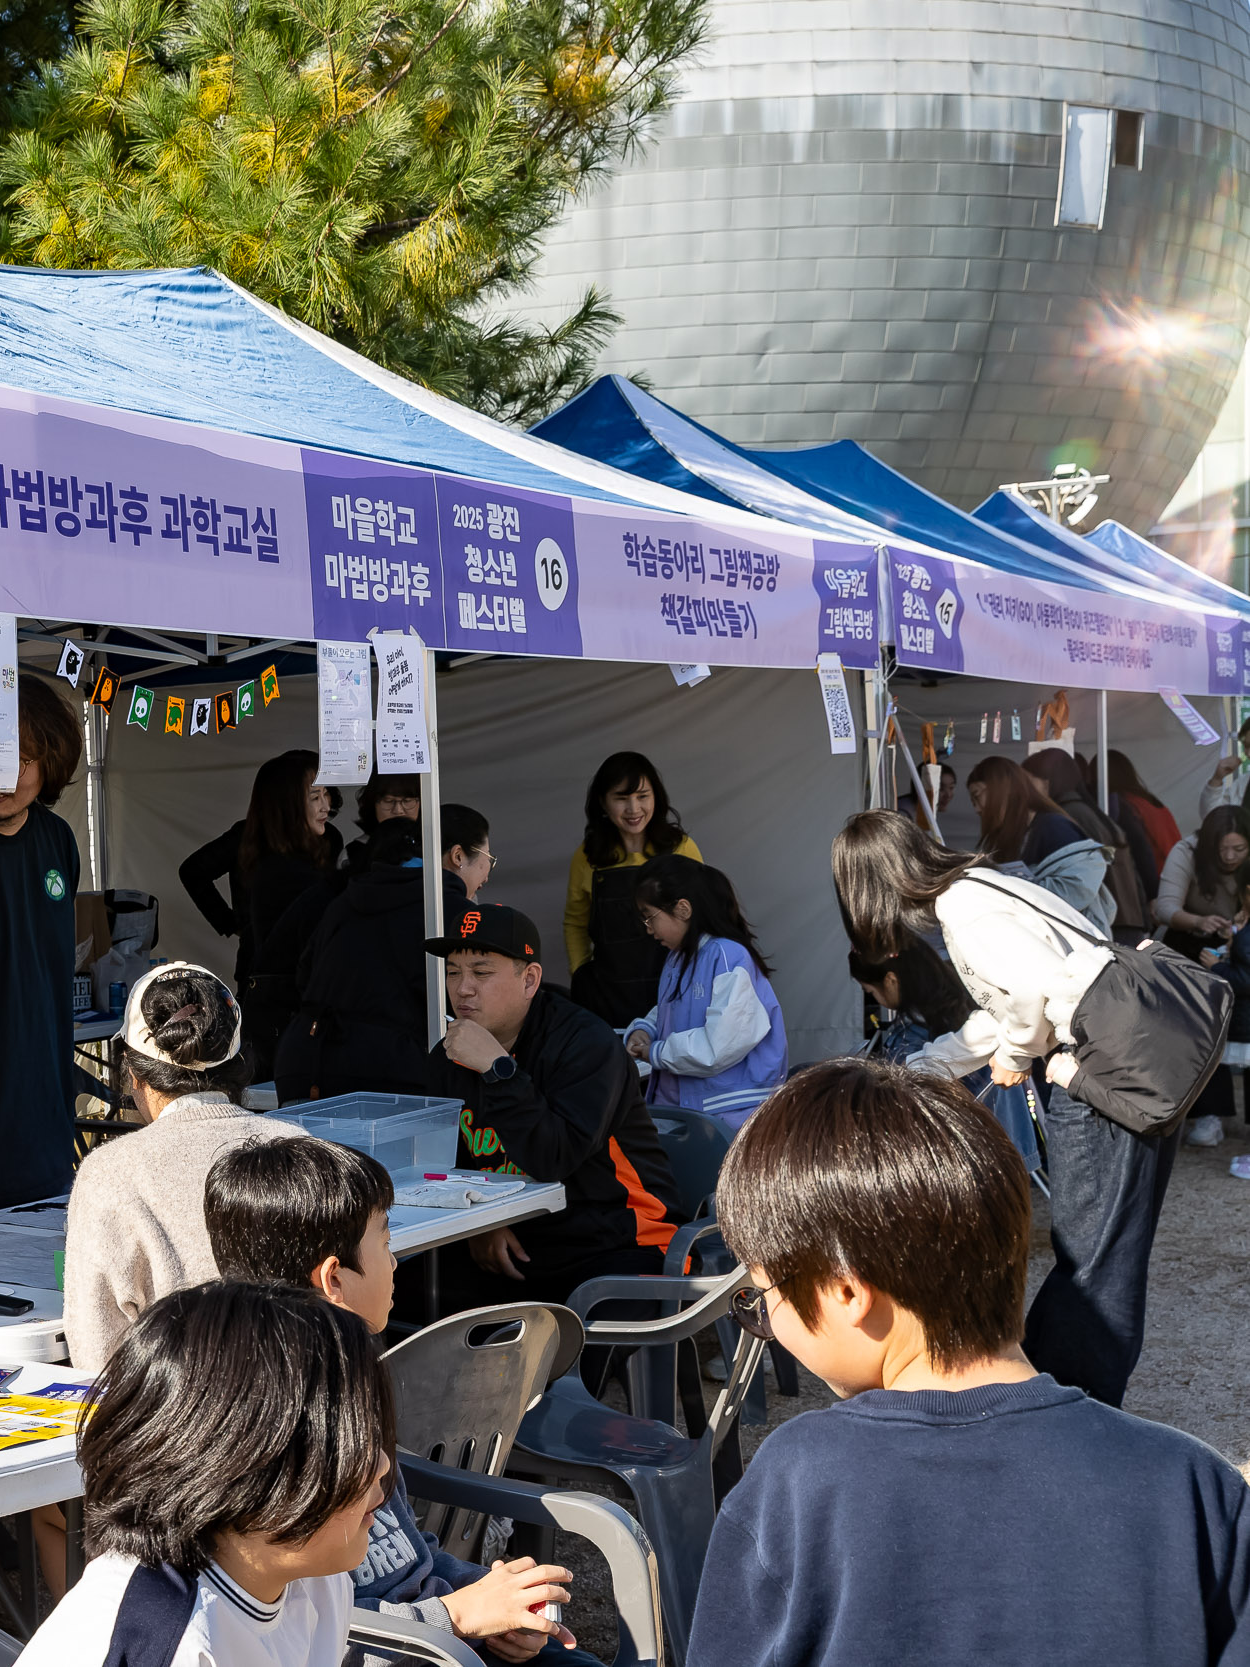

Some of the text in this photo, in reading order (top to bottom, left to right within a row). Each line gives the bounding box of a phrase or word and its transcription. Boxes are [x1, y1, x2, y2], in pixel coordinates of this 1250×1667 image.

[160, 493, 282, 564] 과학교실
[330, 493, 419, 547] 마을학교
[452, 502, 521, 543] 2025 광진
[324, 551, 432, 607] 마법방과후
[464, 543, 518, 588] 청소년
[539, 557, 563, 591] 16
[622, 531, 781, 593] 학습동아리 그림책공방
[457, 591, 528, 635] 페스티벌
[659, 592, 758, 640] 책갈피만들기
[823, 606, 874, 642] 그림책공방
[939, 601, 954, 626] 15
[355, 648, 367, 660] 그림
[386, 650, 396, 667] 우리
